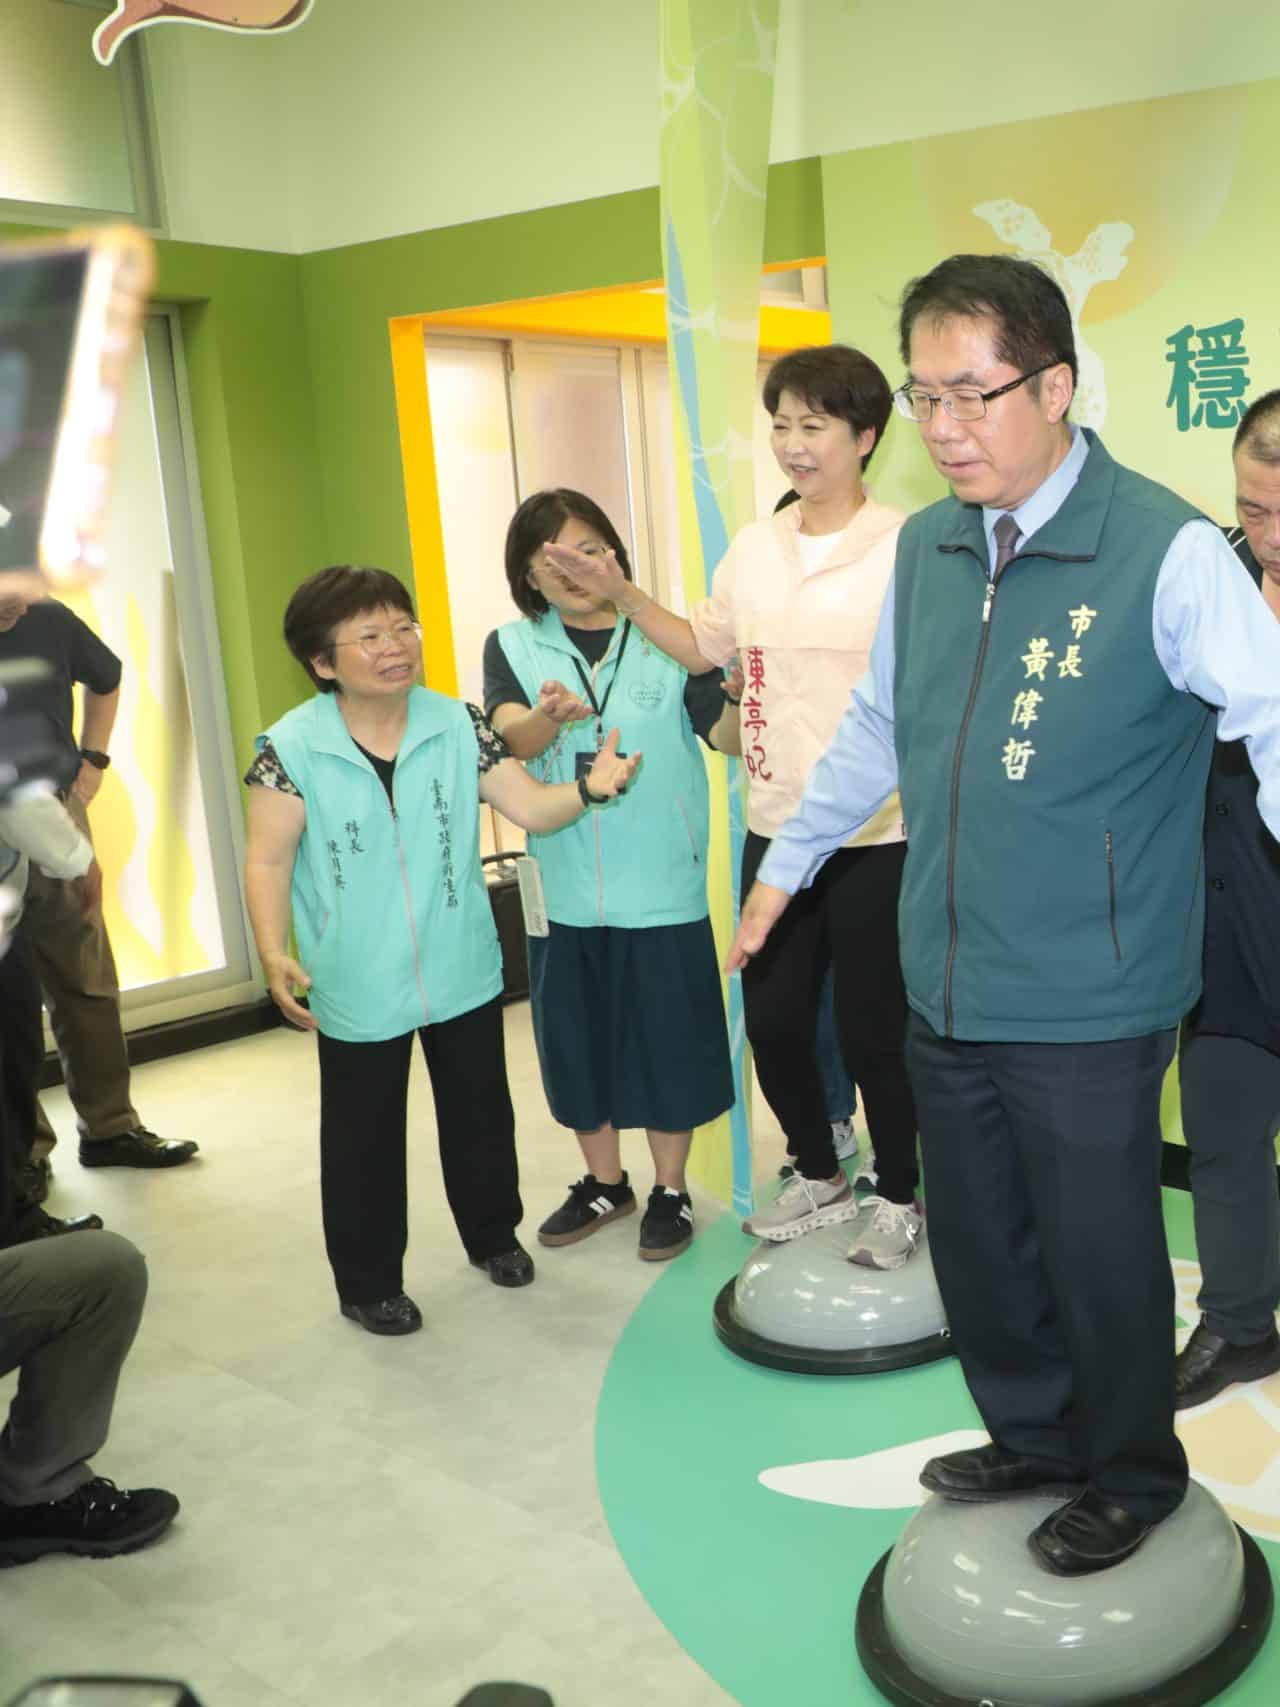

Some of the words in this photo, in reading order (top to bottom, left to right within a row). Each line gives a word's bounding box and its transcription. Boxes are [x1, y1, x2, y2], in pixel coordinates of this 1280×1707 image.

[1166, 318, 1250, 432] 穩
[1057, 604, 1097, 678] 市長
[1001, 637, 1055, 780] 黃偉哲
